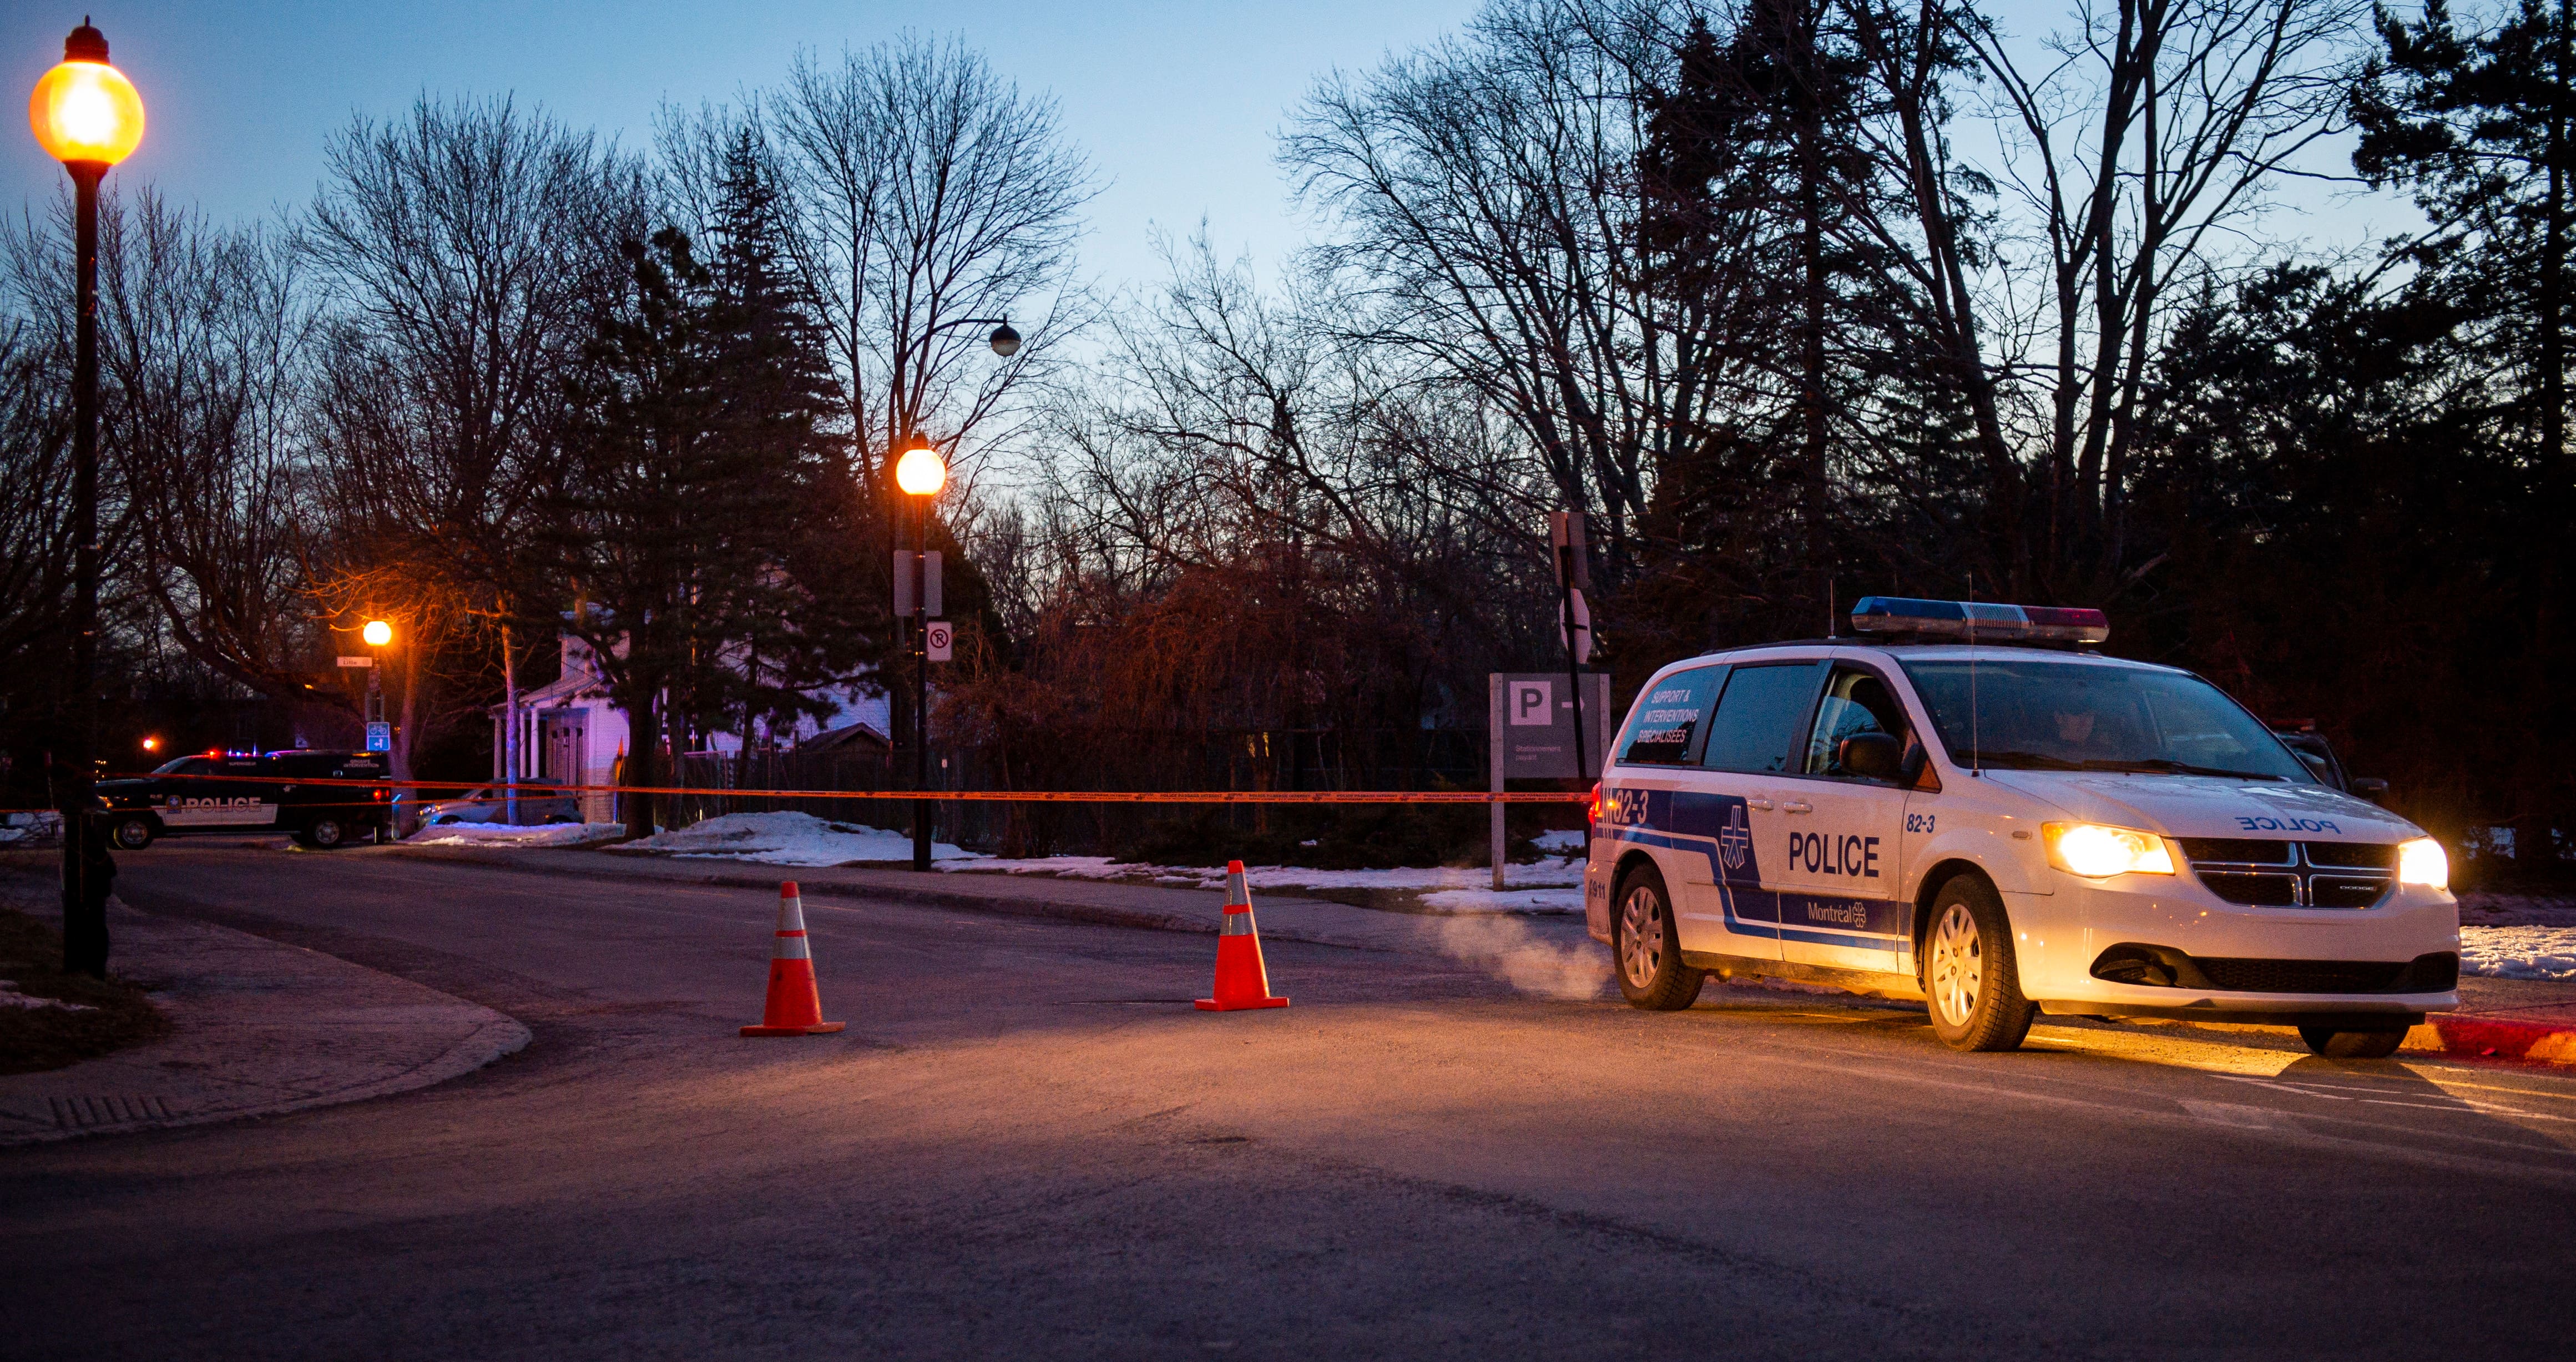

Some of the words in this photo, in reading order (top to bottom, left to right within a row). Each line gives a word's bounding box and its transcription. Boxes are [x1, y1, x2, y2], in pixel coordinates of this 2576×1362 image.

[1521, 688, 1543, 718] P
[1651, 690, 1685, 704] SUPPORT
[1684, 690, 1691, 702] &
[1643, 709, 1699, 723] INTERVENTIONS
[186, 797, 261, 813] POLICE
[1907, 813, 1935, 833] 82-3
[1790, 832, 1880, 877] POLICE
[1808, 901, 1852, 923] Montréal
